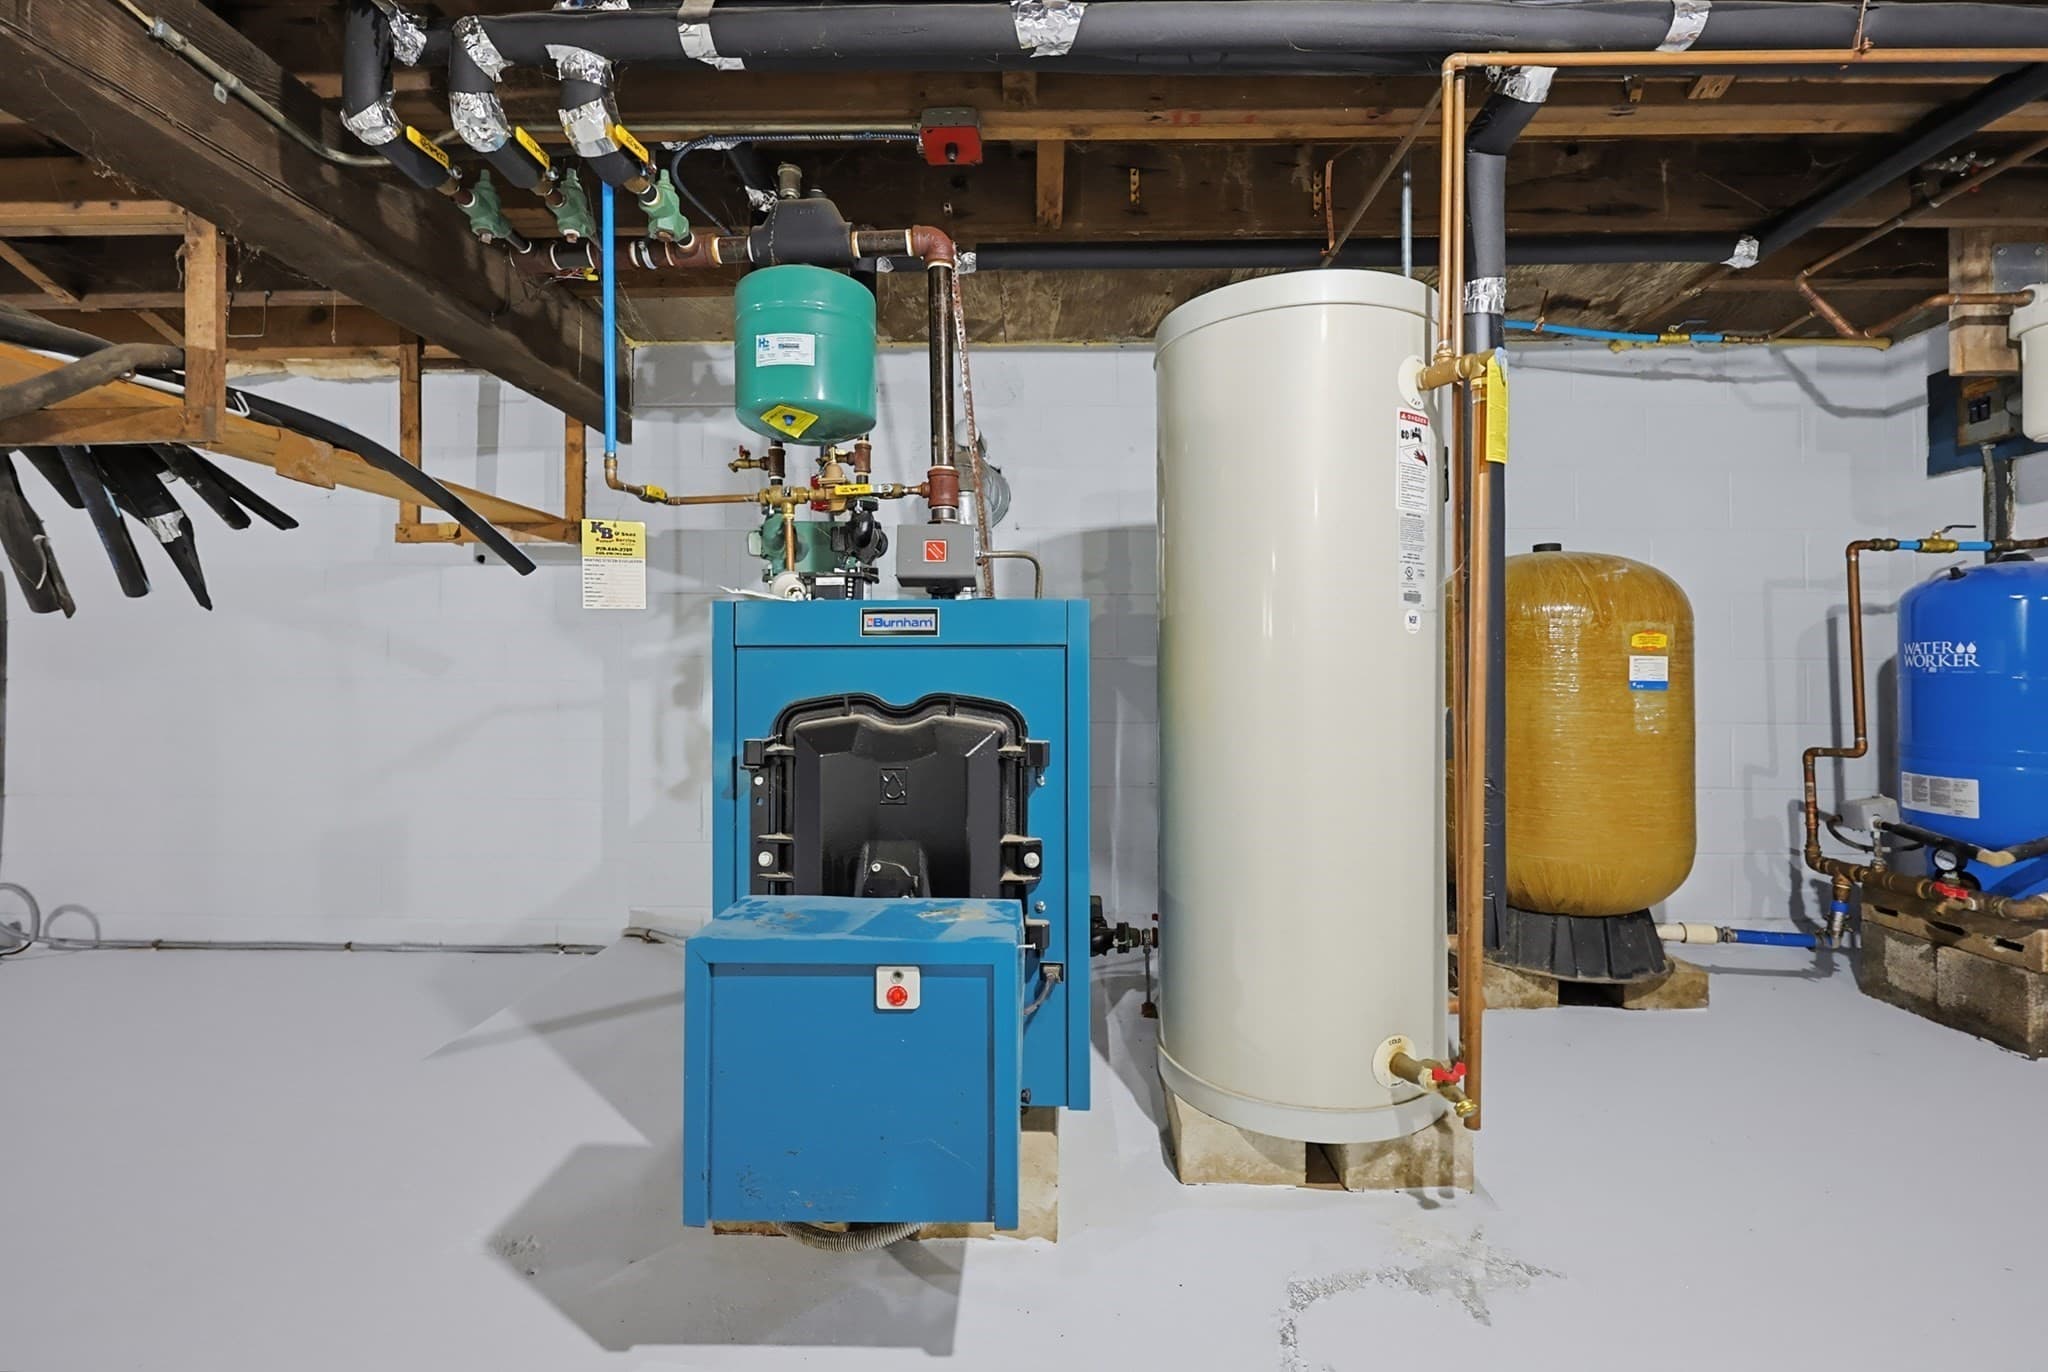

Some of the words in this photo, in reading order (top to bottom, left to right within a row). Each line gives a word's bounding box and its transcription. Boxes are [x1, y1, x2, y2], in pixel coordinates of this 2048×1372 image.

[873, 616, 933, 628] Burnham
[1903, 641, 1955, 655] WATER
[1903, 653, 1981, 668] WORKER
